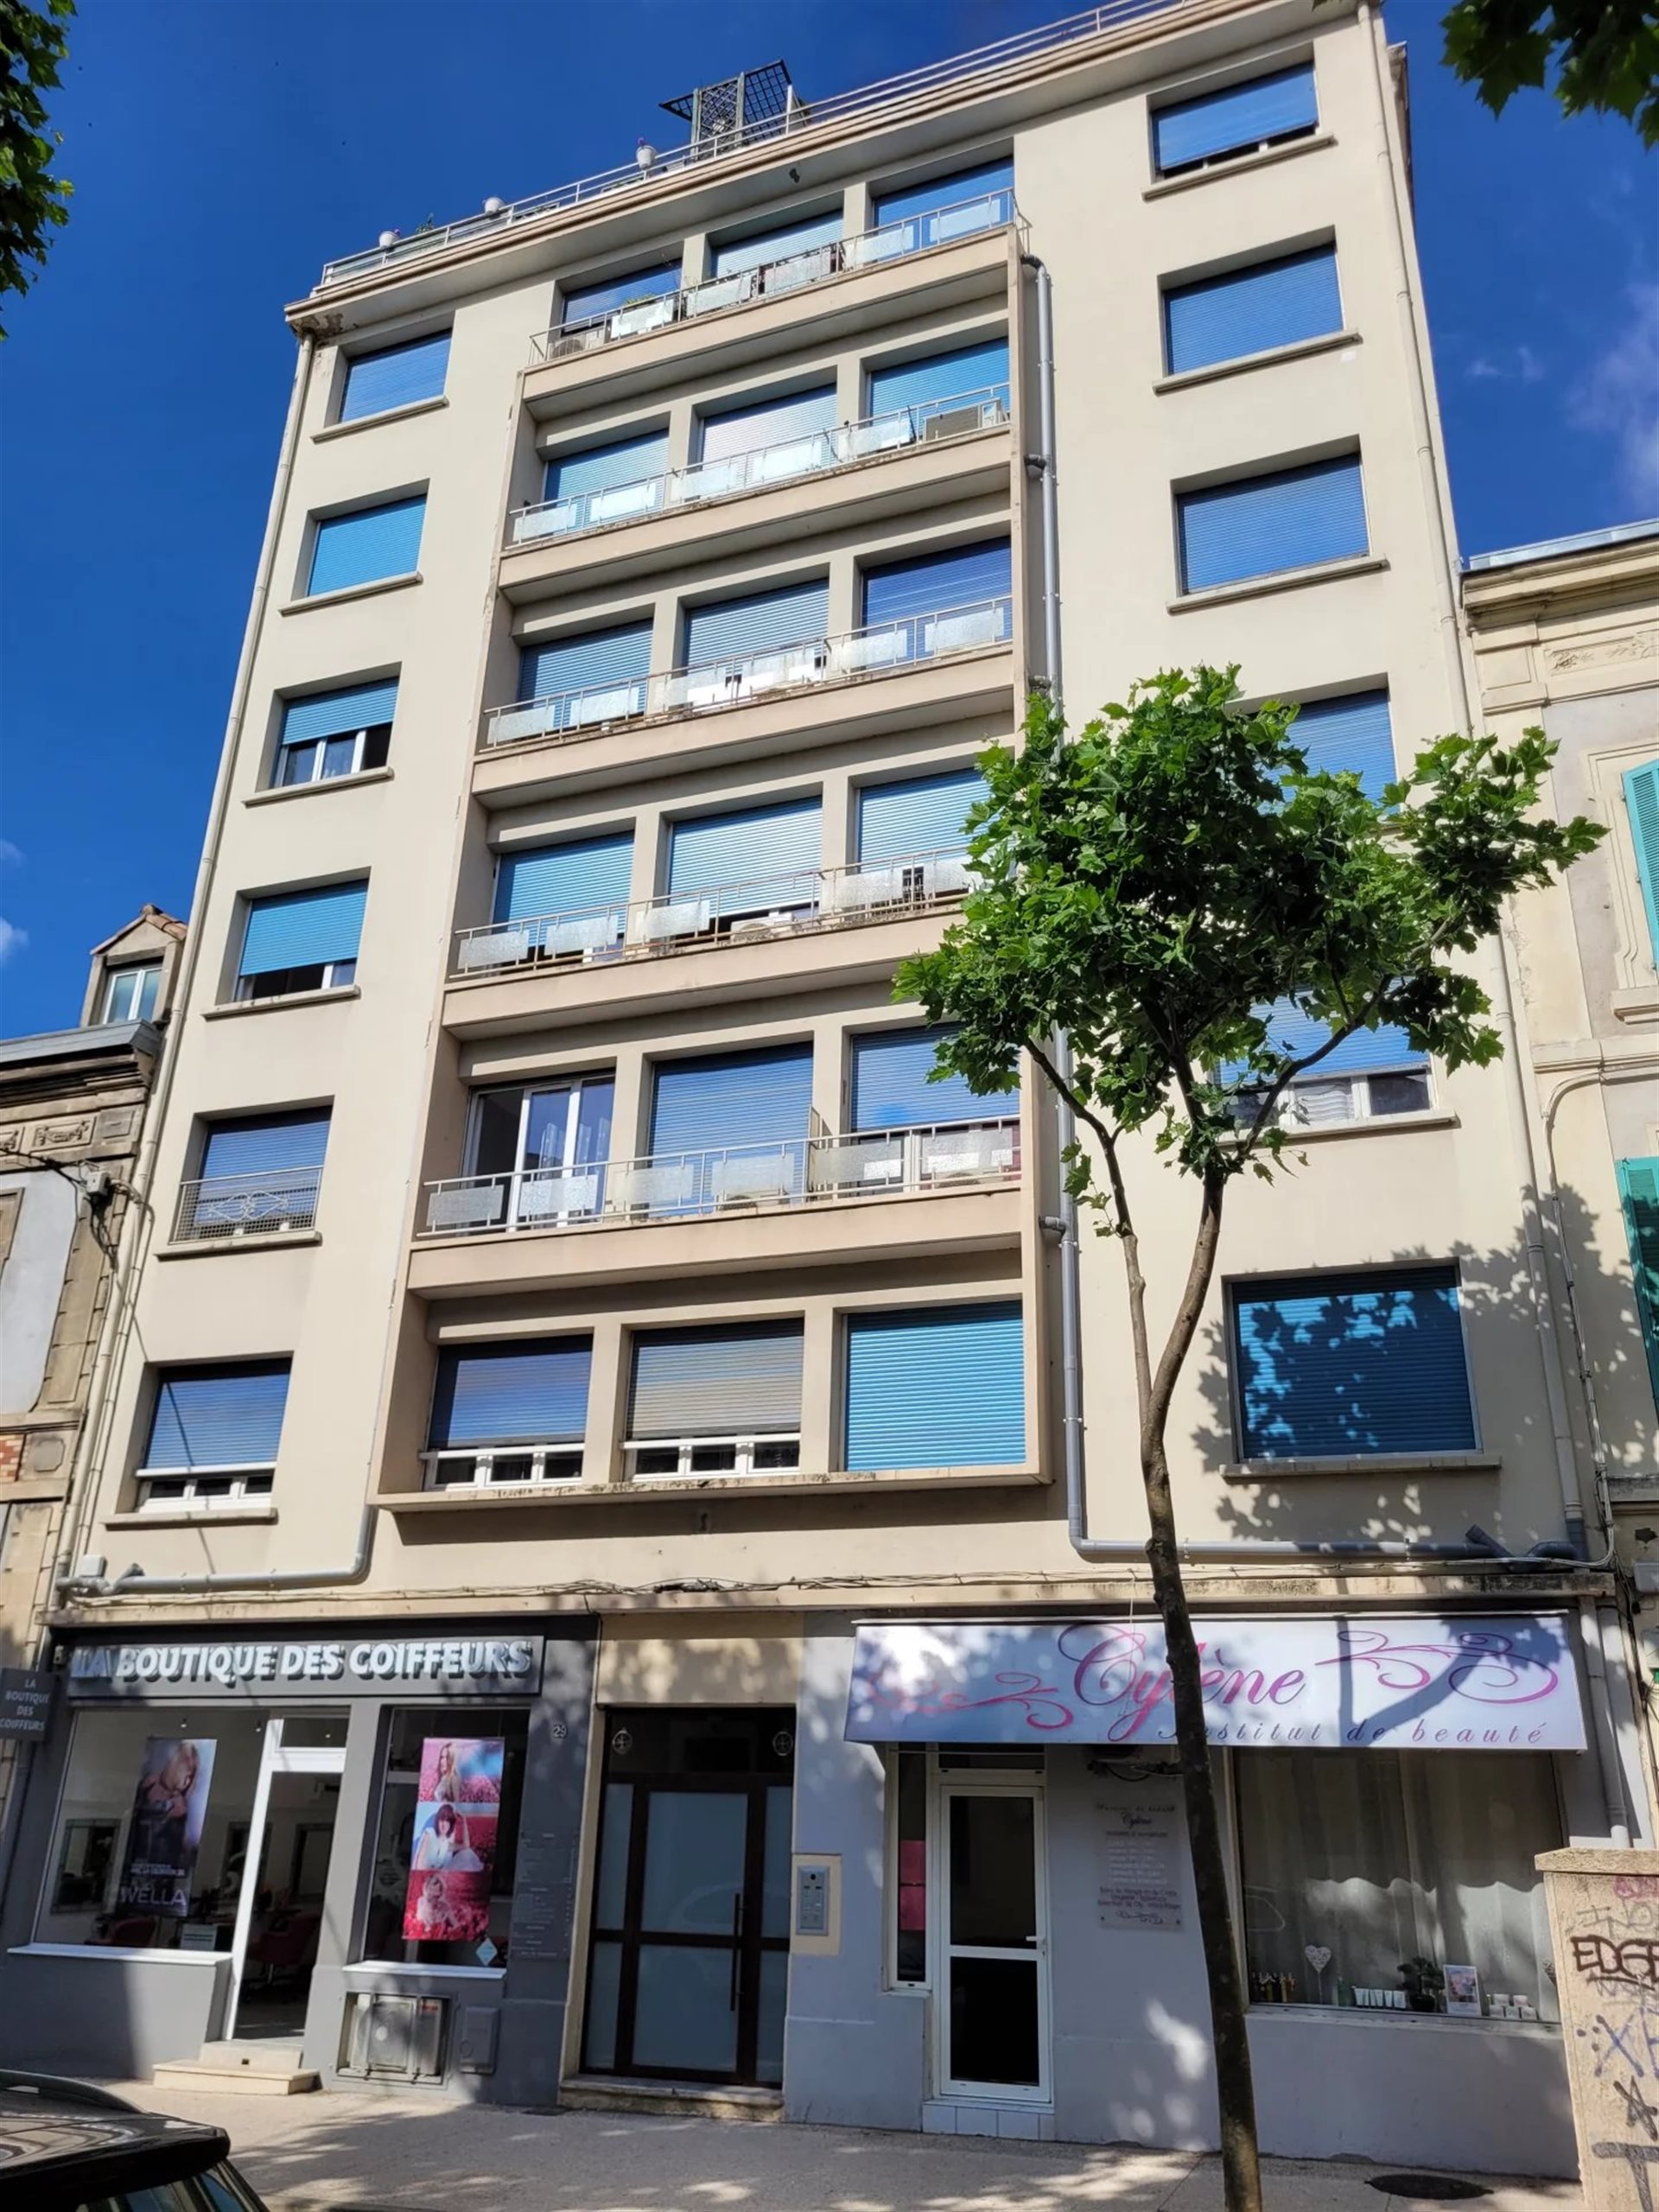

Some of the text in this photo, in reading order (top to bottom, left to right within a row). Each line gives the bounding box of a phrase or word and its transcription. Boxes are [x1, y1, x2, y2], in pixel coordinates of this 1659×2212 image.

[71, 1640, 532, 1684] LA BOUTIQUE DES COIFFEURS
[23, 1677, 37, 1689] LA
[1057, 1623, 1306, 1743] Cyène
[16, 1705, 35, 1717] DES
[553, 1724, 567, 1738] 29
[1345, 1718, 1386, 1741] de
[1411, 1719, 1548, 1744] beauté
[121, 1885, 188, 1906] WELLA
